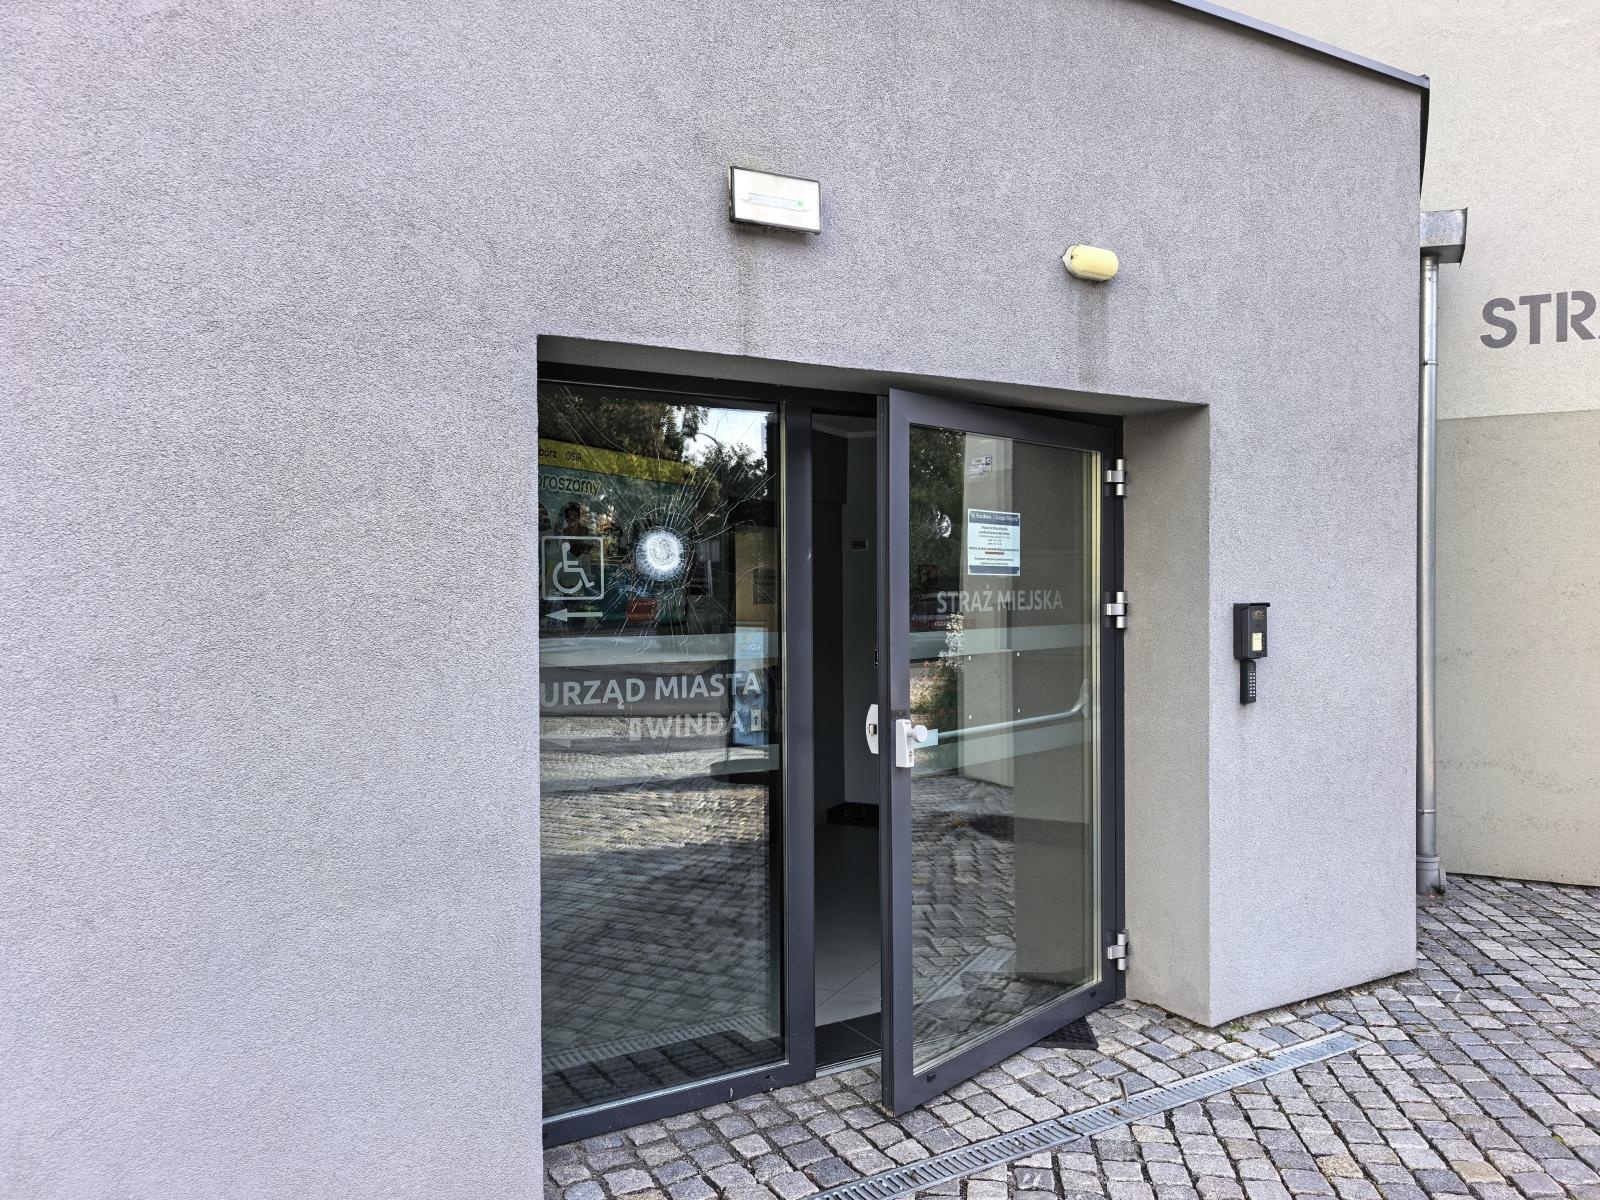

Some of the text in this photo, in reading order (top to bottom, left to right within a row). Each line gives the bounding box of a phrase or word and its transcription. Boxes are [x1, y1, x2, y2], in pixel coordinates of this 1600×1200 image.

[1480, 290, 1600, 349] STR
[936, 584, 1063, 614] STRAŻ MIEJSKA
[541, 672, 762, 709] URZĄD MIASTA
[646, 710, 745, 740] WINDA
